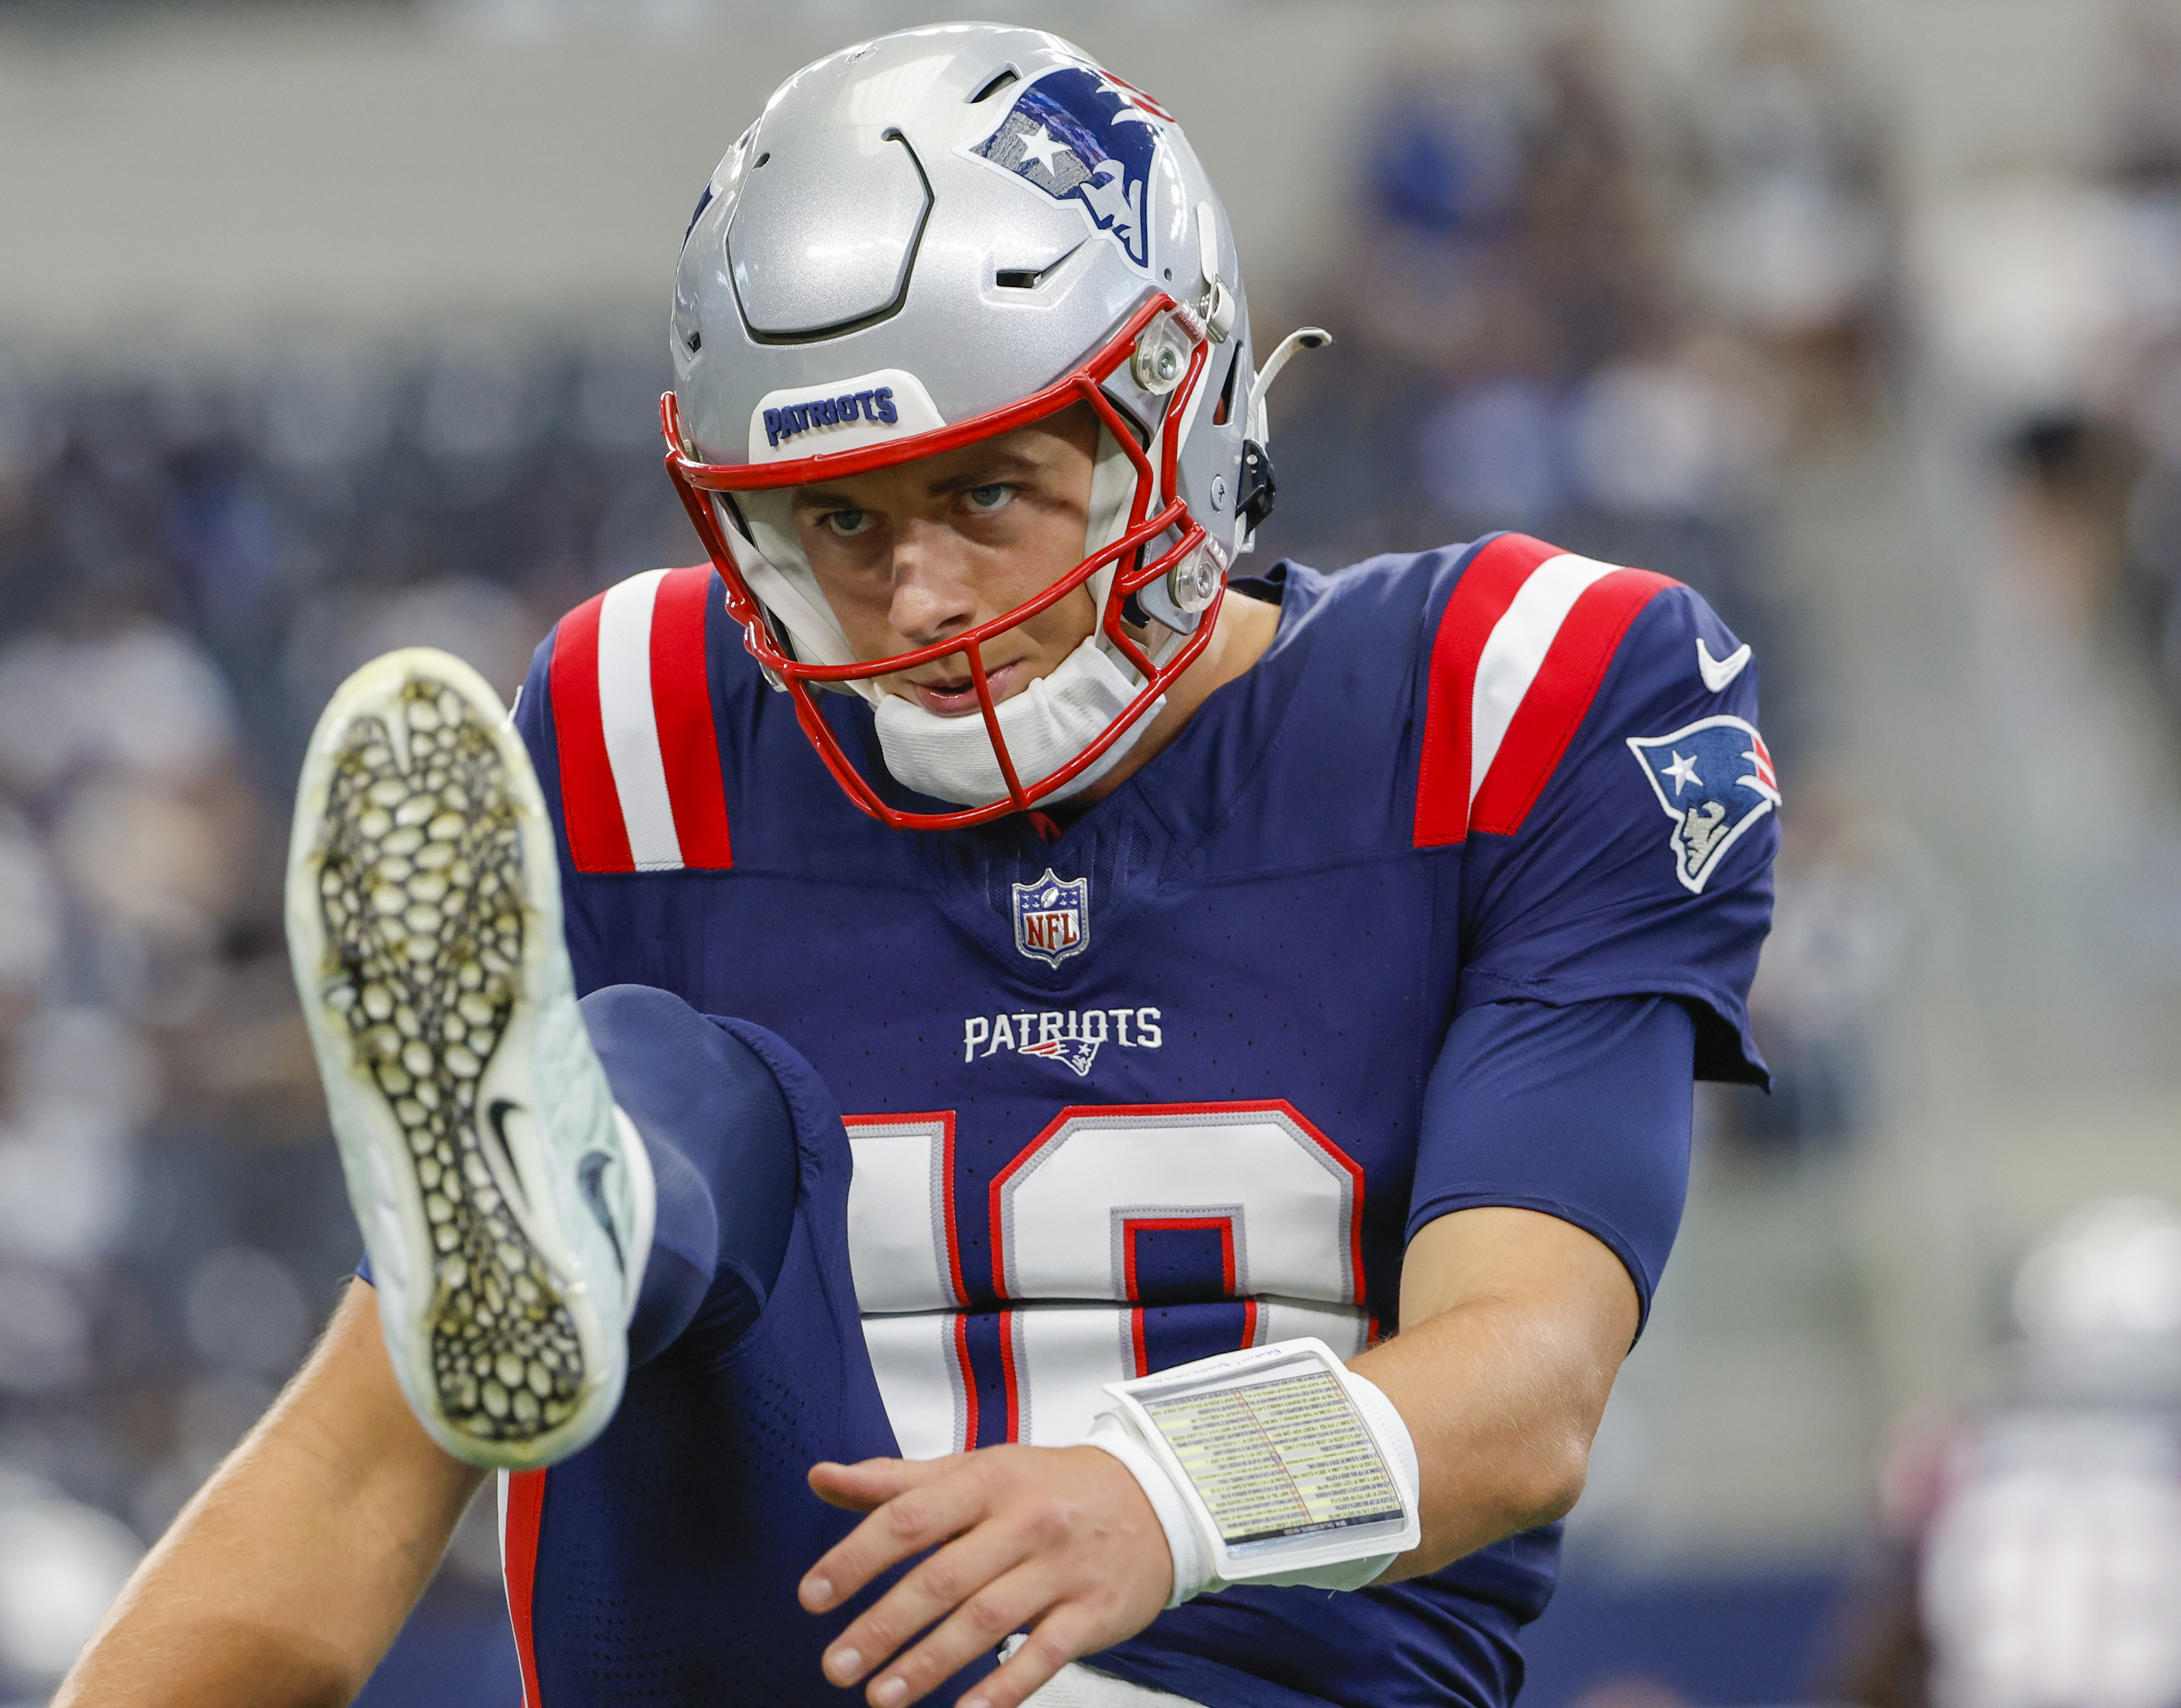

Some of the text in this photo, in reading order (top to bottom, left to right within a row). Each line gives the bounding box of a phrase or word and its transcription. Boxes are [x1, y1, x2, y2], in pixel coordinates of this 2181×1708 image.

[763, 386, 898, 447] PATRIOTS
[1027, 913, 1076, 950] NFL
[963, 1007, 1162, 1063] PATRIOTS
